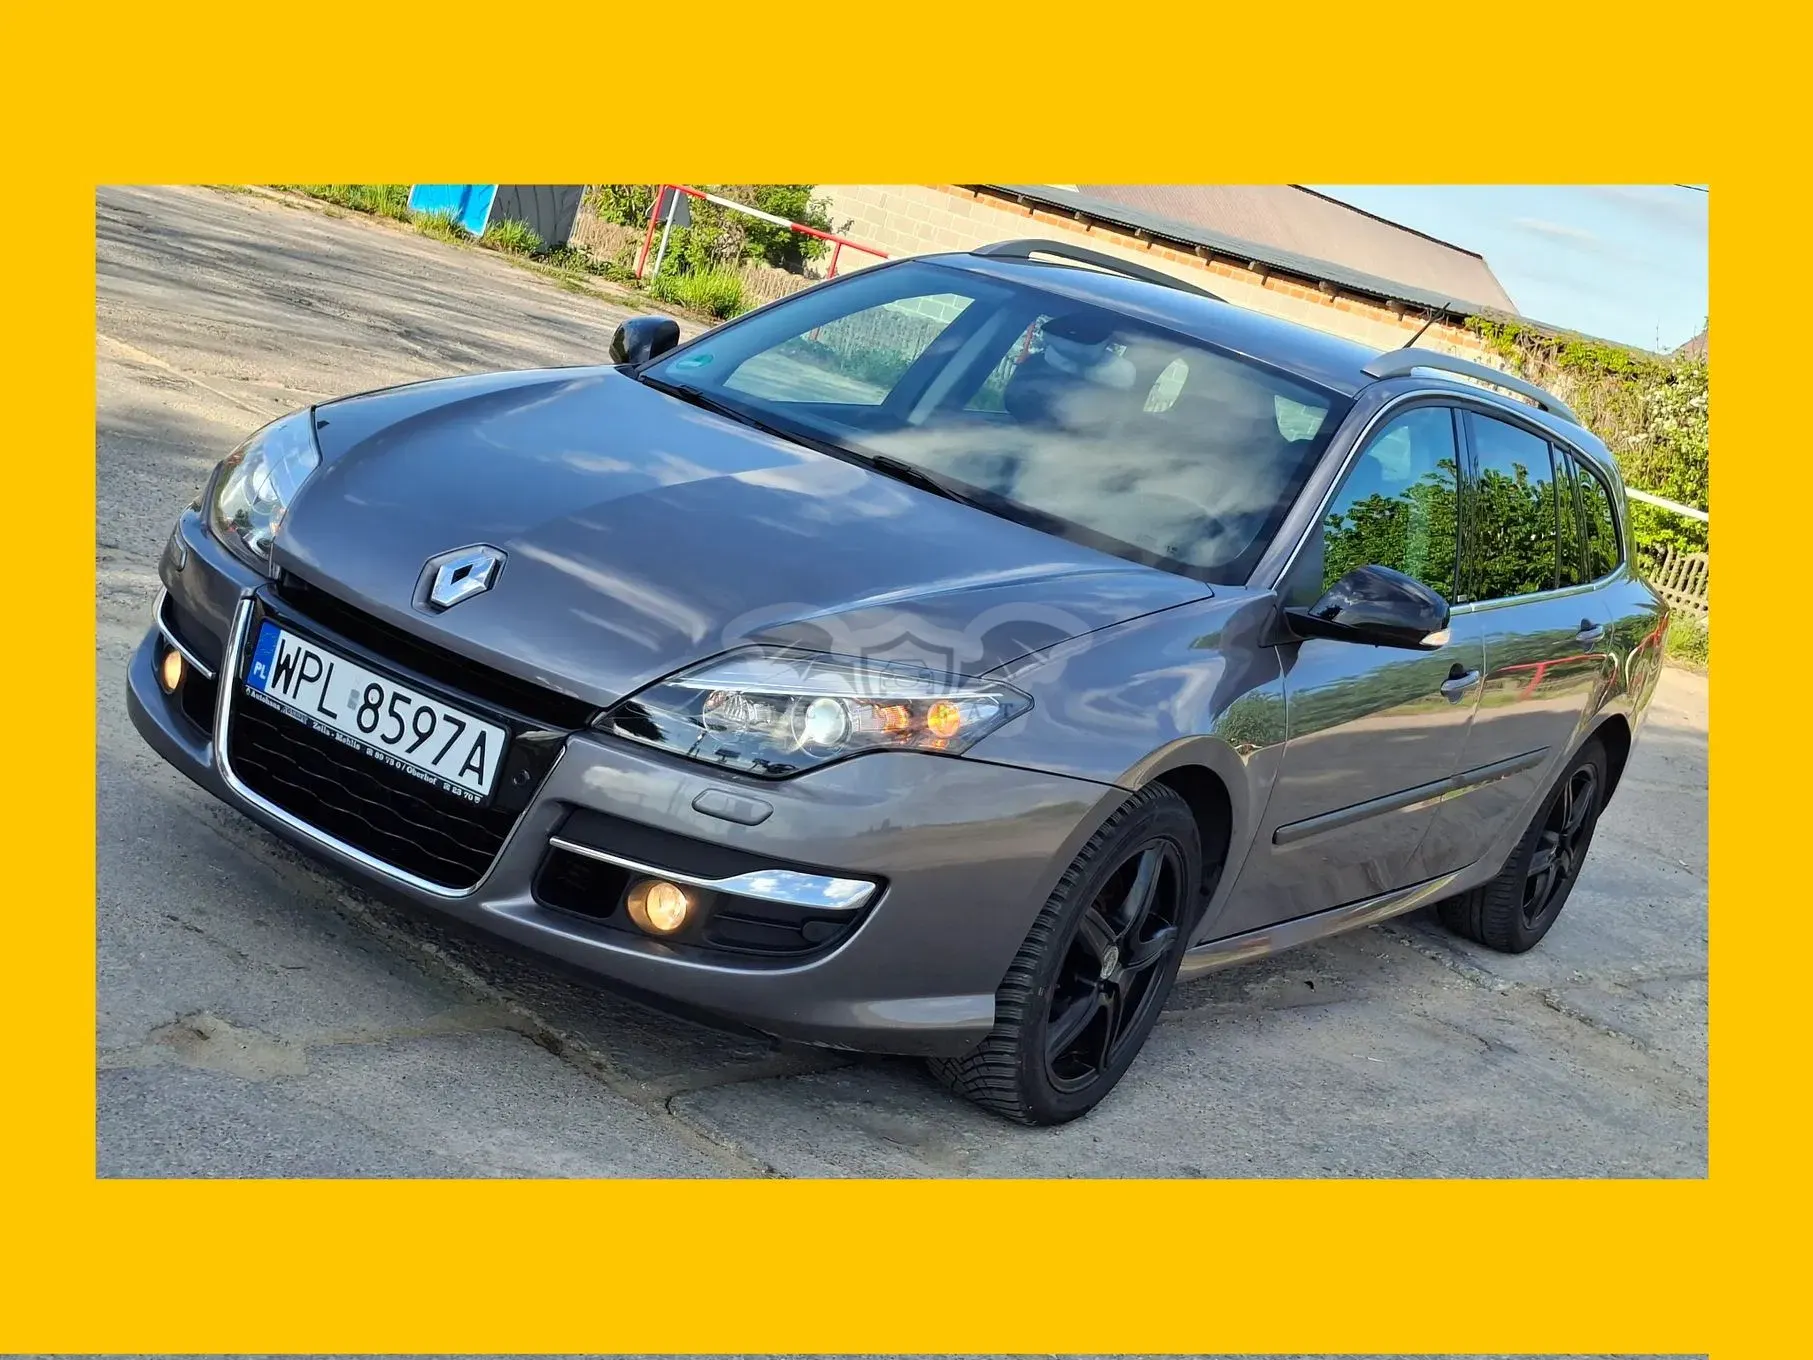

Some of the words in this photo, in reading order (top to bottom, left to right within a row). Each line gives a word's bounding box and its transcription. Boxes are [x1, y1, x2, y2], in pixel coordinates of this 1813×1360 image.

[253, 661, 268, 681] PL
[270, 638, 338, 719] WPL
[356, 682, 488, 786] 8597A
[406, 766, 438, 785] Oberhof
